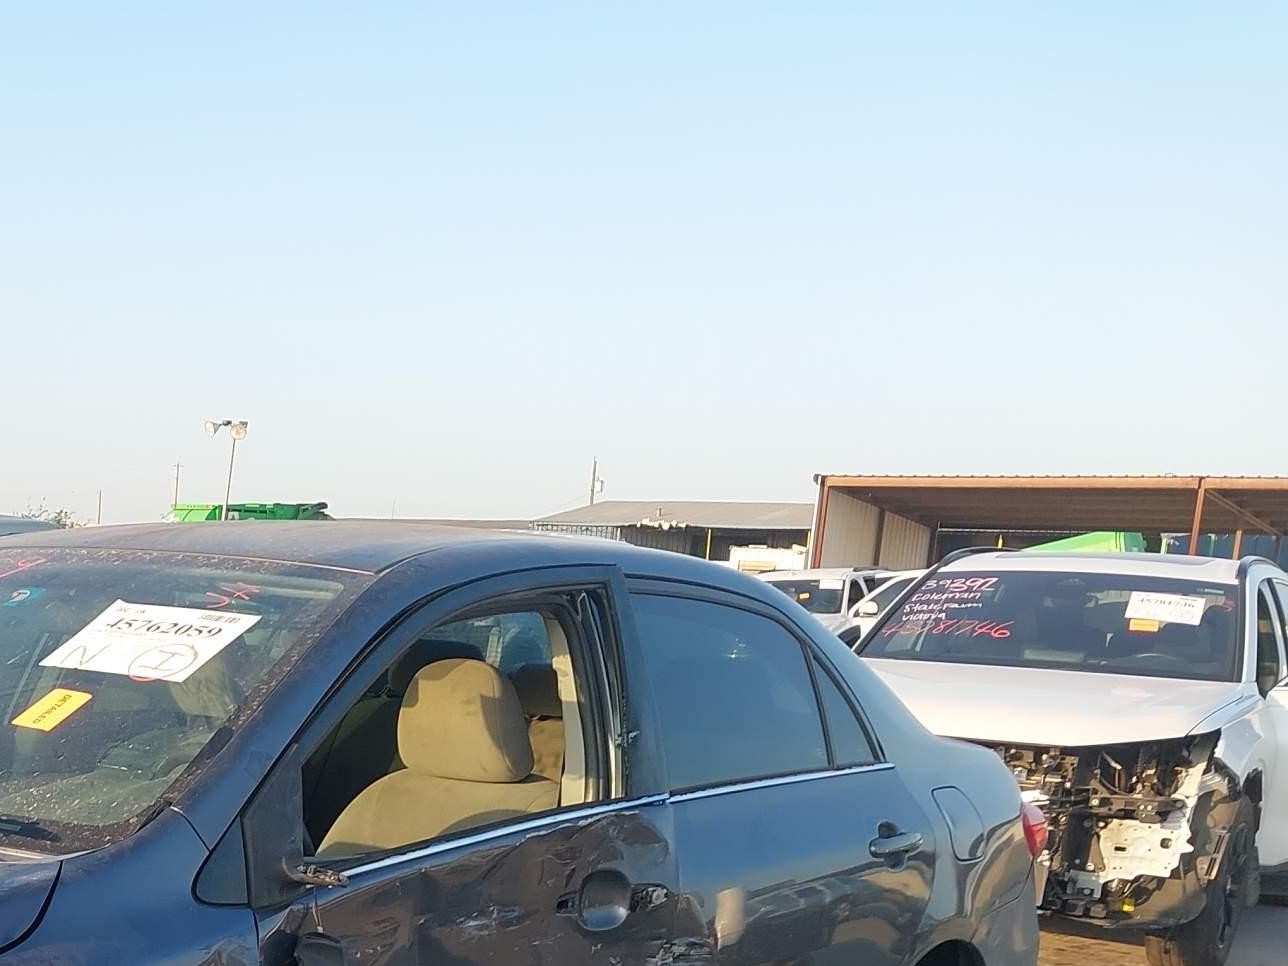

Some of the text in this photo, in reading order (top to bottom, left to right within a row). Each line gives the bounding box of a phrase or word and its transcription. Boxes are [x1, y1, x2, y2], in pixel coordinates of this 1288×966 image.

[105, 617, 223, 639] 45762059
[60, 644, 112, 666] N
[32, 694, 73, 725] DETAILED
